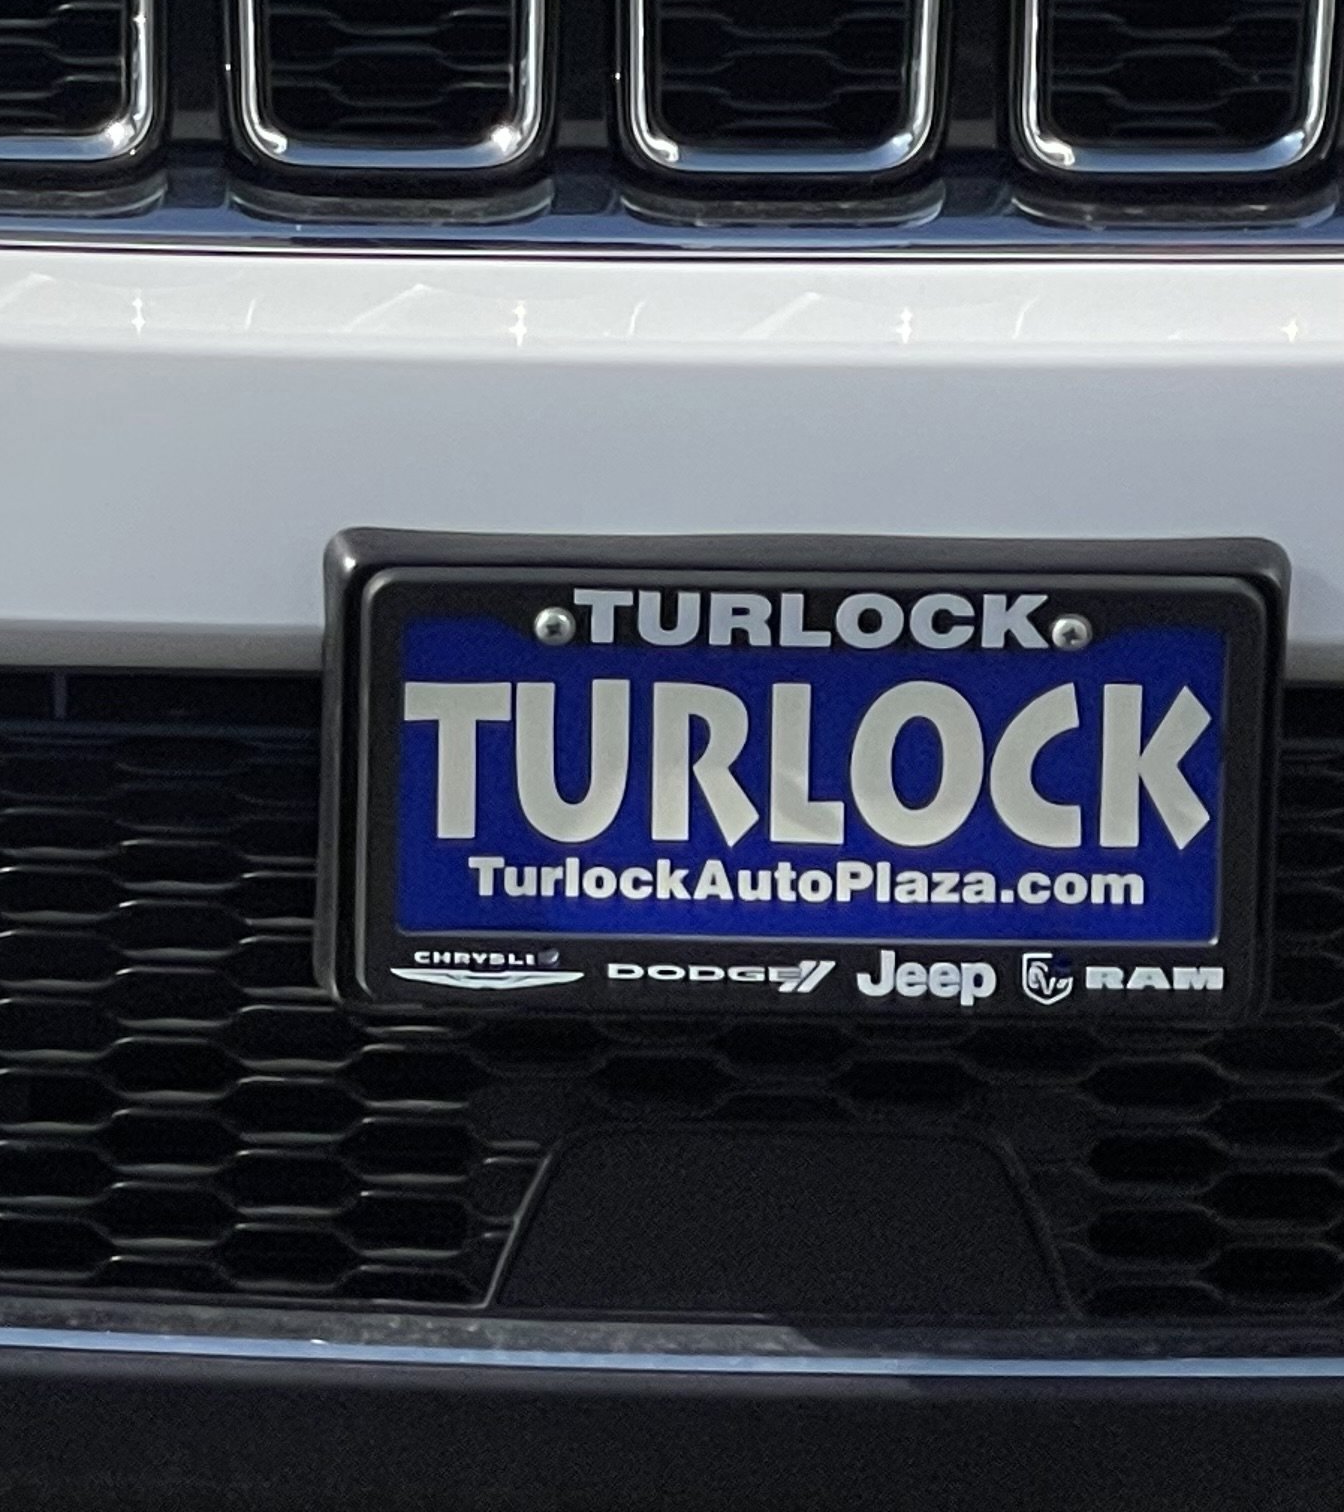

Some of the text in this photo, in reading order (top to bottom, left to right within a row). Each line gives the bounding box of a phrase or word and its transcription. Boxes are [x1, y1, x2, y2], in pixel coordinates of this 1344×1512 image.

[574, 588, 1050, 650] TURLOCK
[403, 678, 1212, 852] TURLOCK
[468, 856, 1145, 906] TurlockAutoPlaza.com
[606, 962, 801, 983] DODGE
[856, 949, 997, 1007] Jeep
[1084, 965, 1225, 991] RAM
